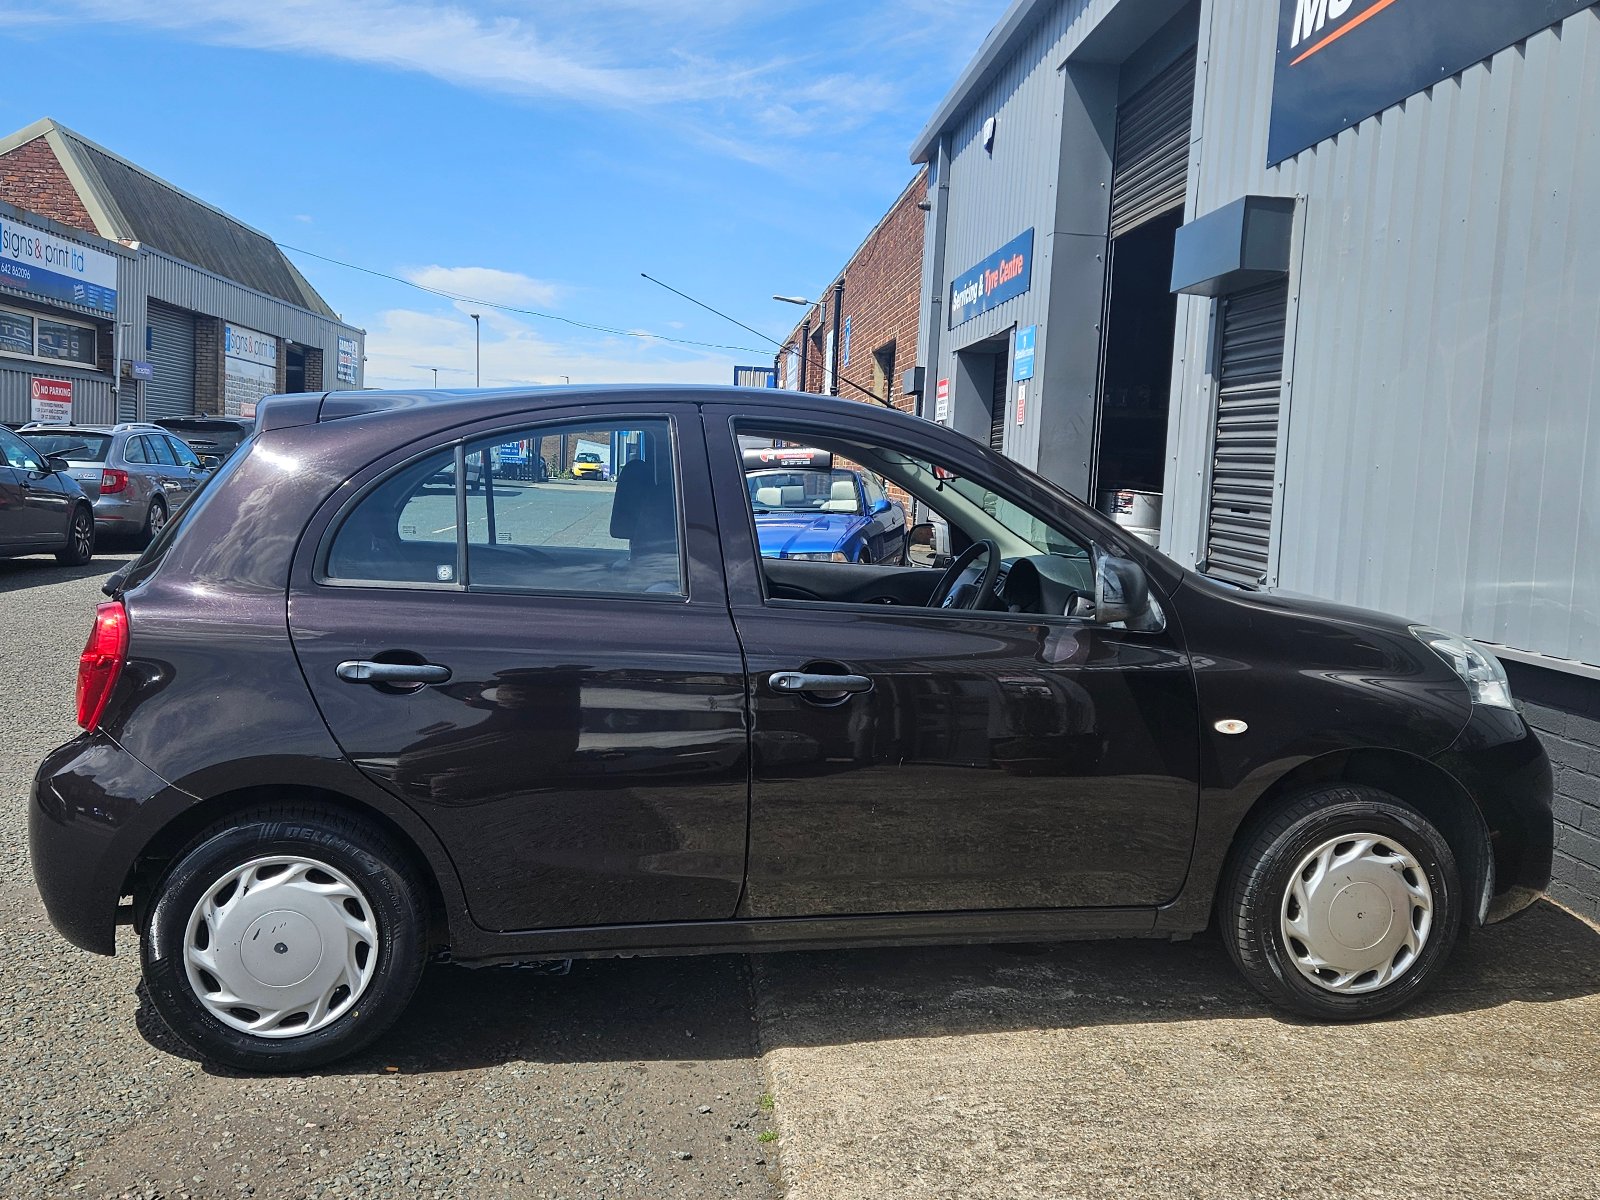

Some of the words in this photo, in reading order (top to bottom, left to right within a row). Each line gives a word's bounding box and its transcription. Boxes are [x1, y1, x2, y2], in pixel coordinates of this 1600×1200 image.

[2, 226, 33, 259] signs
[35, 238, 42, 259] &
[45, 243, 69, 267] print
[71, 247, 84, 272] ltd
[0, 263, 11, 275] 642
[11, 265, 31, 279] 862096
[952, 280, 978, 312] Servicing
[978, 274, 984, 297] &
[985, 269, 998, 296] Tyre
[1000, 254, 1023, 284] Centre
[230, 330, 248, 355] signs
[248, 336, 253, 354] &
[254, 339, 268, 358] print
[40, 386, 49, 395] NO
[49, 386, 71, 397] PARKING
